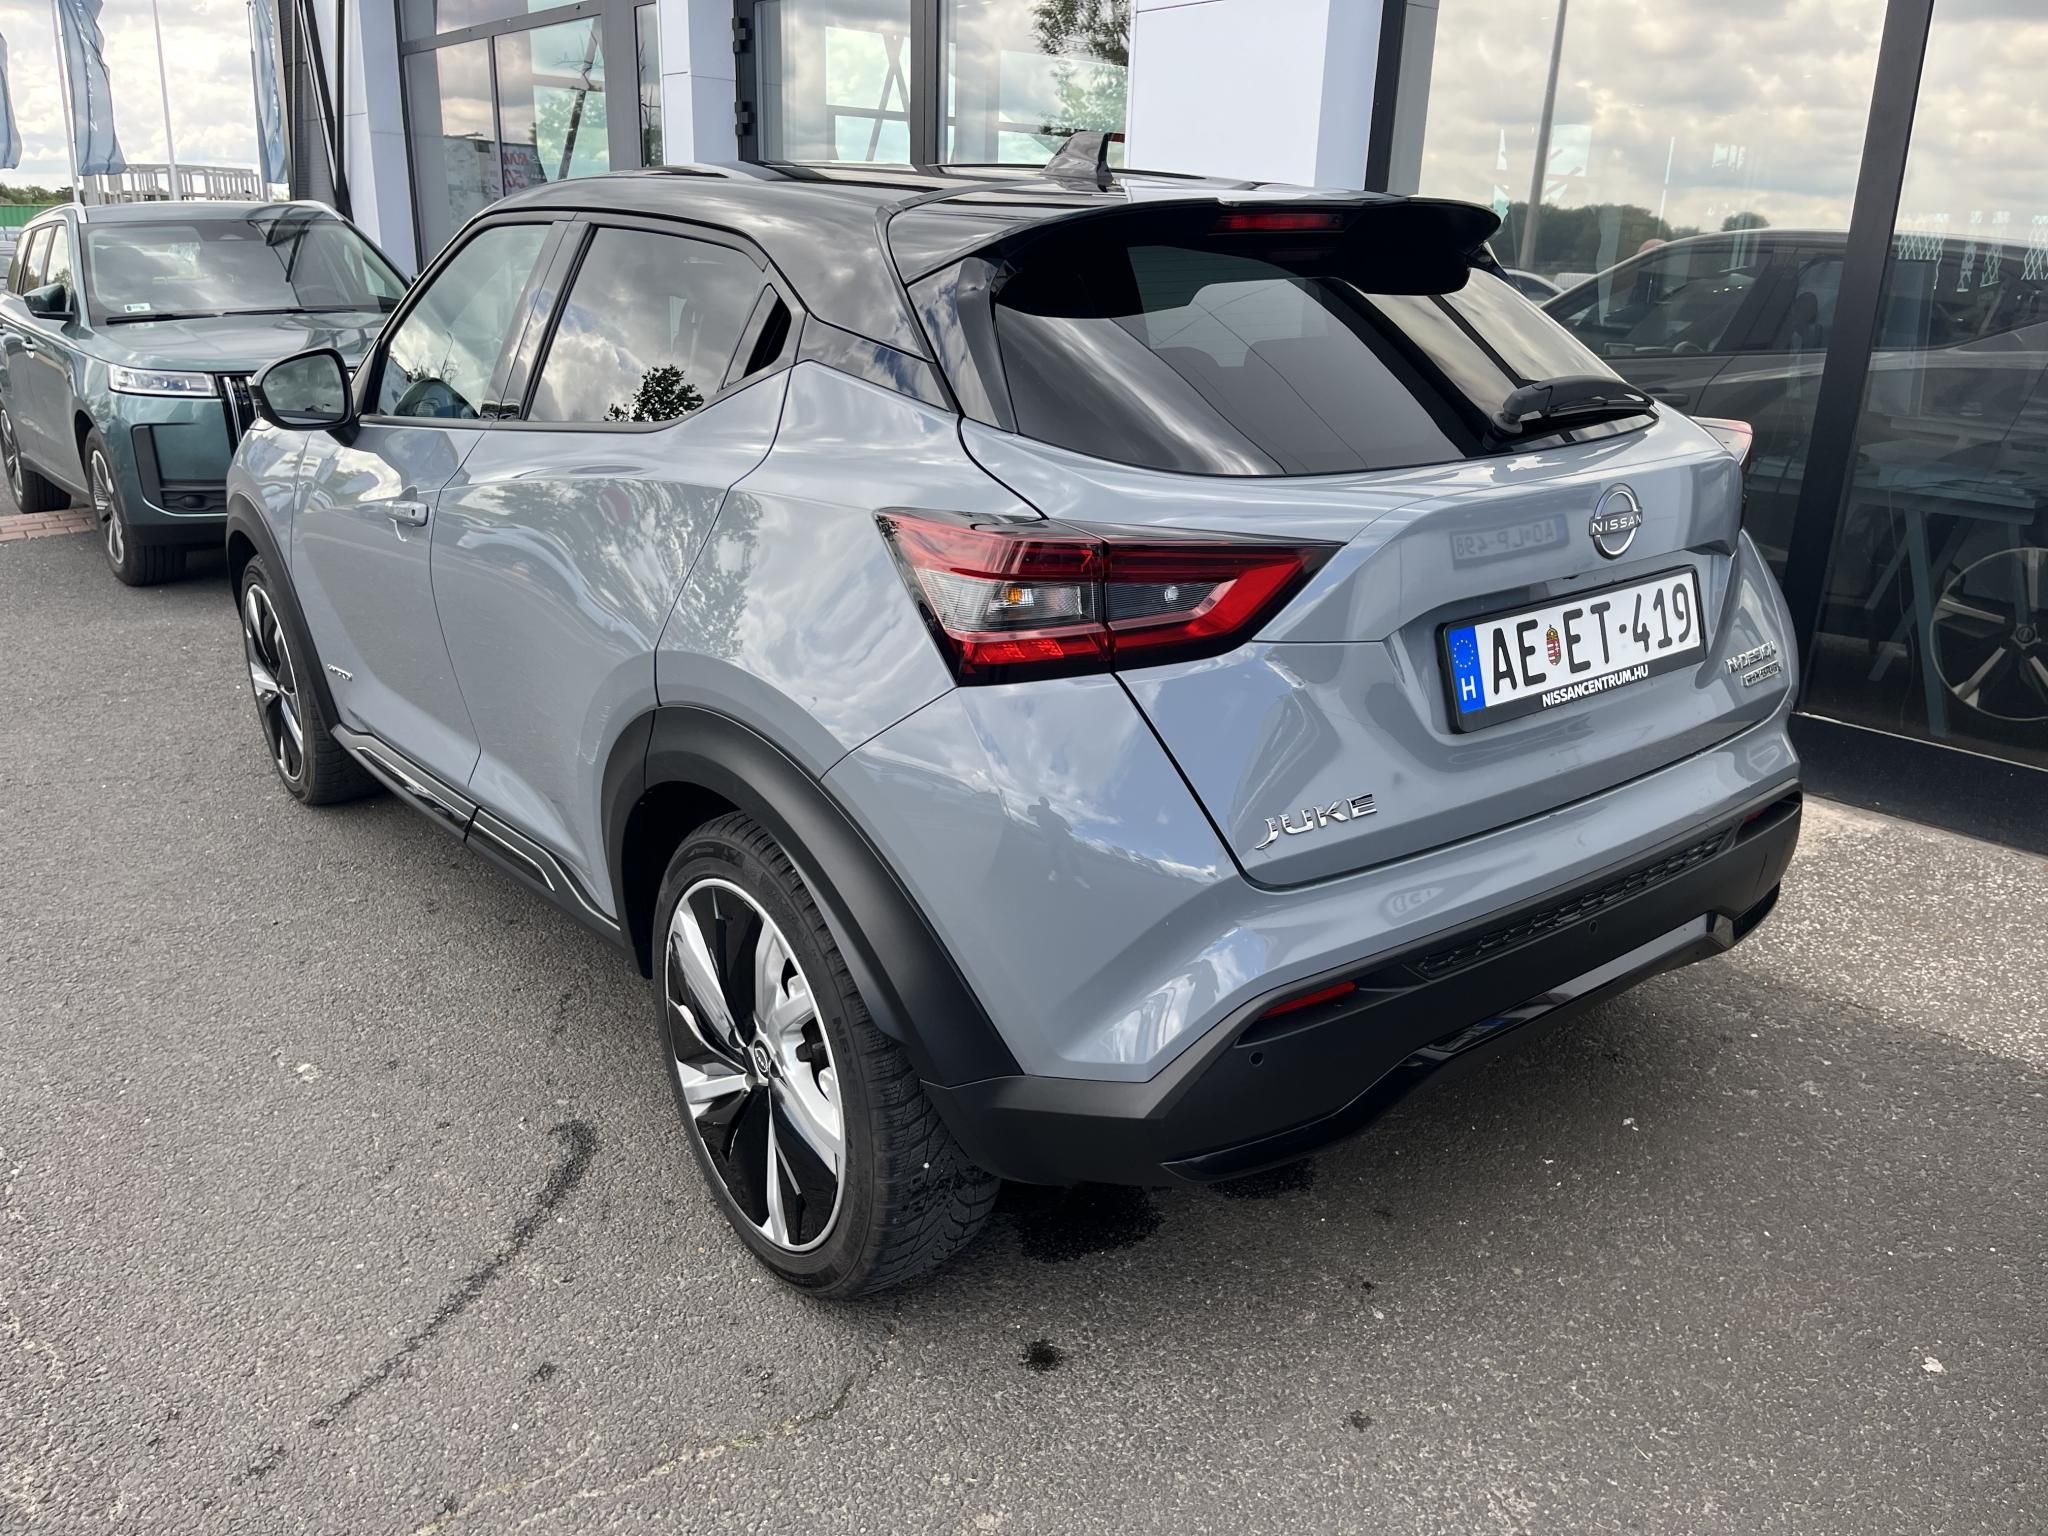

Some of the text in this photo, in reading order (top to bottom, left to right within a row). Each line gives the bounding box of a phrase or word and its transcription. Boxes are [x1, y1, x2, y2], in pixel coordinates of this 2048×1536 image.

[1591, 512, 1642, 534] NISSAN
[1461, 675, 1478, 702] H
[1541, 663, 1650, 708] NISSANCENTRUM.HU
[1254, 792, 1378, 851] JUKE
